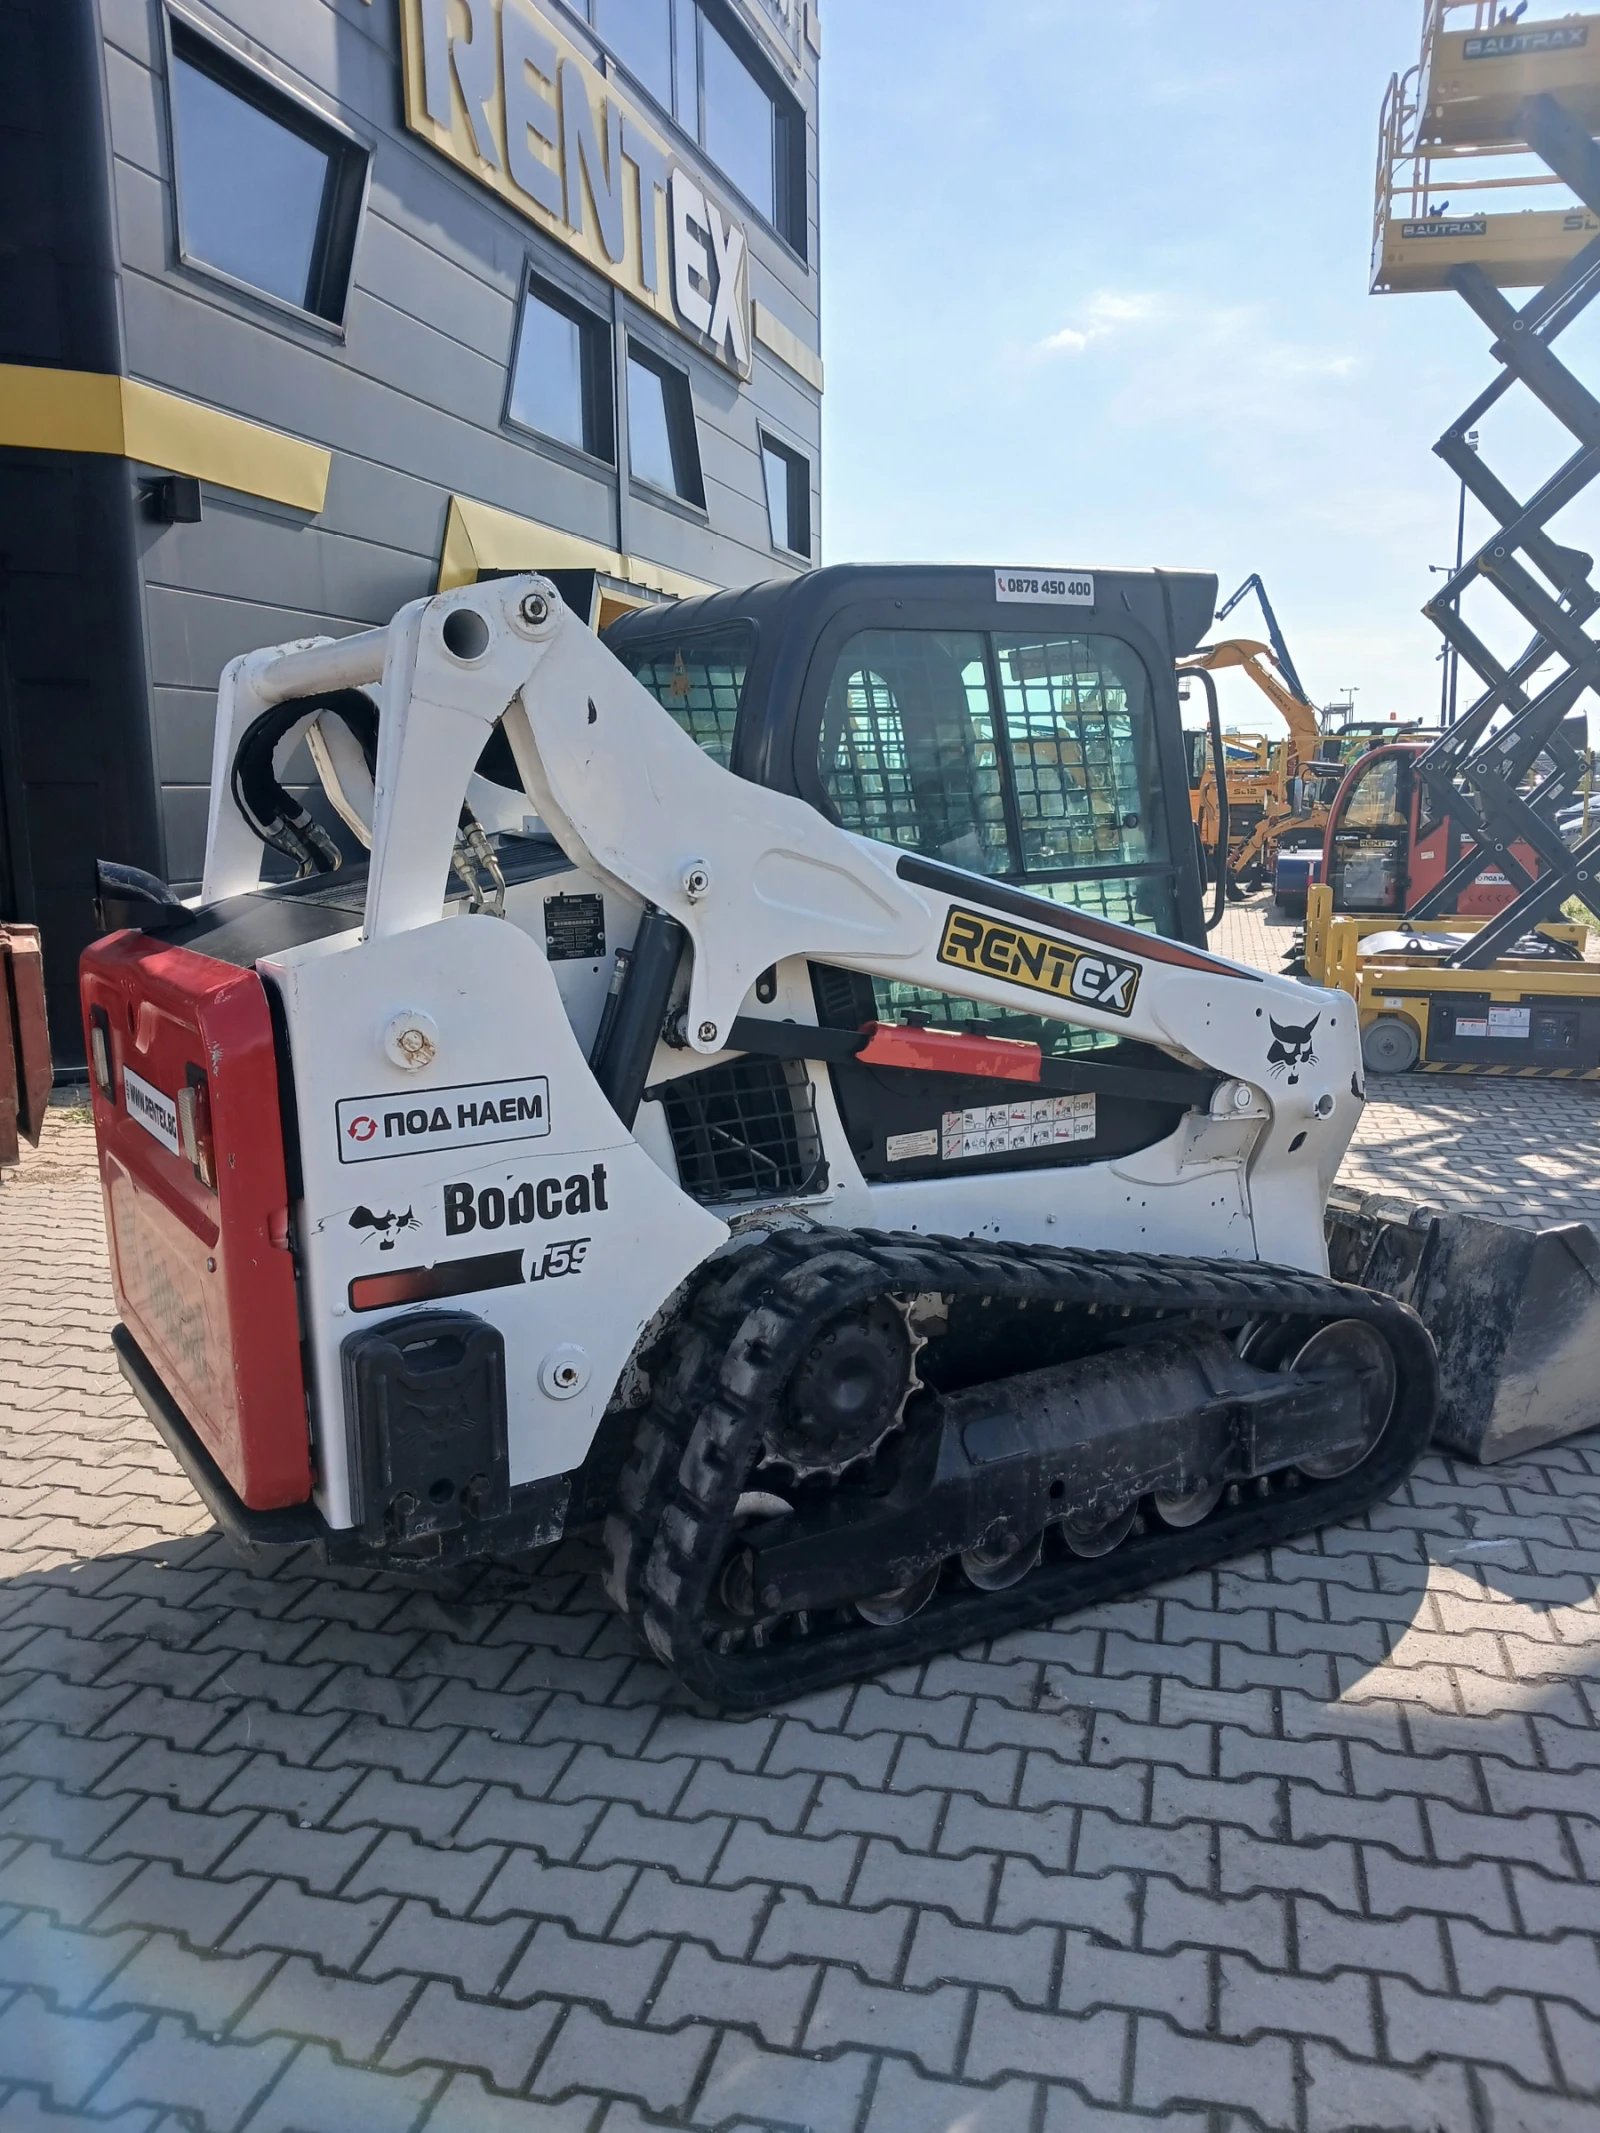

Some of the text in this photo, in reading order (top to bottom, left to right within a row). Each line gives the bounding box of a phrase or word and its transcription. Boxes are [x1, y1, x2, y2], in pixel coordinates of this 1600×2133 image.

[1465, 28, 1585, 56] BAUTRAX
[420, 0, 750, 368] RENTEX
[1404, 222, 1485, 235] BAUTRAX
[1007, 578, 1091, 596] 0878 450 400
[946, 916, 1134, 1009] RENTEX
[384, 1094, 543, 1138] ПОД НАЕМ
[443, 1163, 608, 1237] Bobcat
